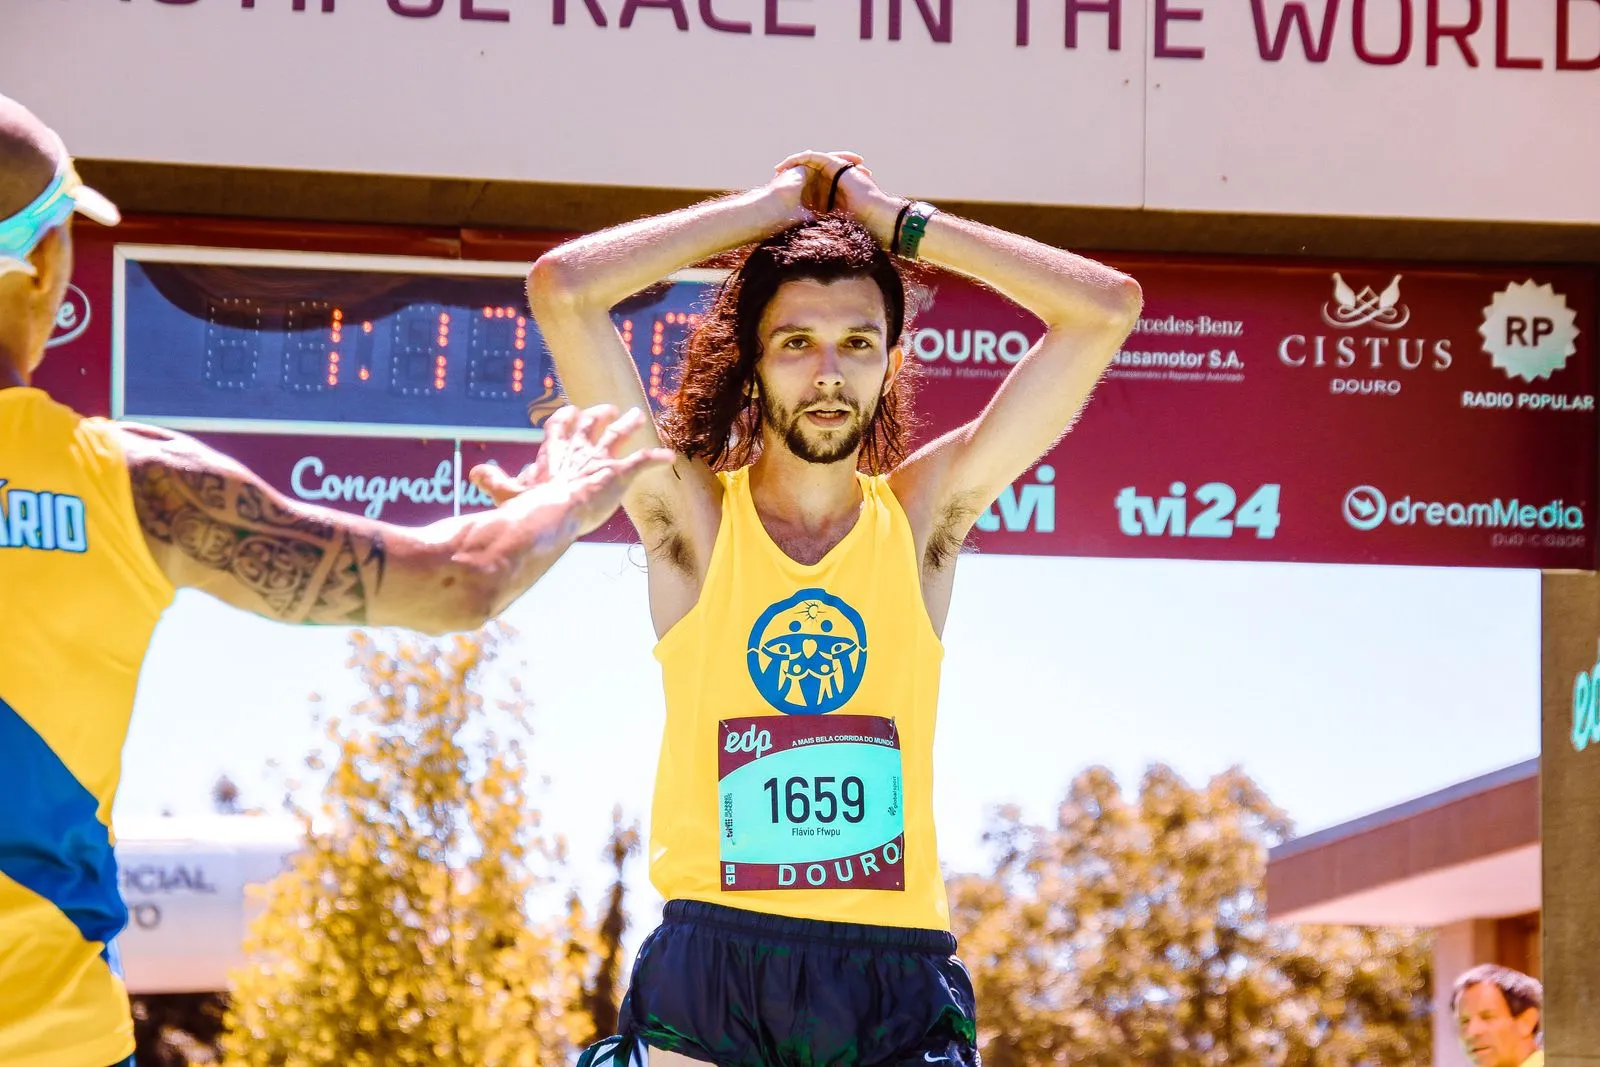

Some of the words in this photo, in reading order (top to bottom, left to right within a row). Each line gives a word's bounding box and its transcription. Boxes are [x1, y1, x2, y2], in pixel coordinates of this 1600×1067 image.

[1252, 0, 1600, 71] WORLD
[1134, 314, 1243, 336] rcedes-Benz
[1505, 315, 1555, 347] RP
[1208, 349, 1245, 369] S.A.
[1278, 334, 1453, 370] CISTUS
[1331, 378, 1401, 394] DOURO
[1462, 390, 1514, 408] RADIO
[1517, 393, 1594, 411] POPULAR
[1114, 481, 1281, 539] tvi24
[1389, 496, 1585, 529] dreamMedia
[724, 724, 773, 759] edp
[797, 735, 815, 745] MAIS
[816, 735, 834, 743] BELA
[874, 738, 894, 747] MUNDO
[763, 776, 865, 824] 1659
[791, 827, 815, 836] Flávio
[816, 827, 841, 837] Ffwpu
[778, 842, 901, 886] DOURO
